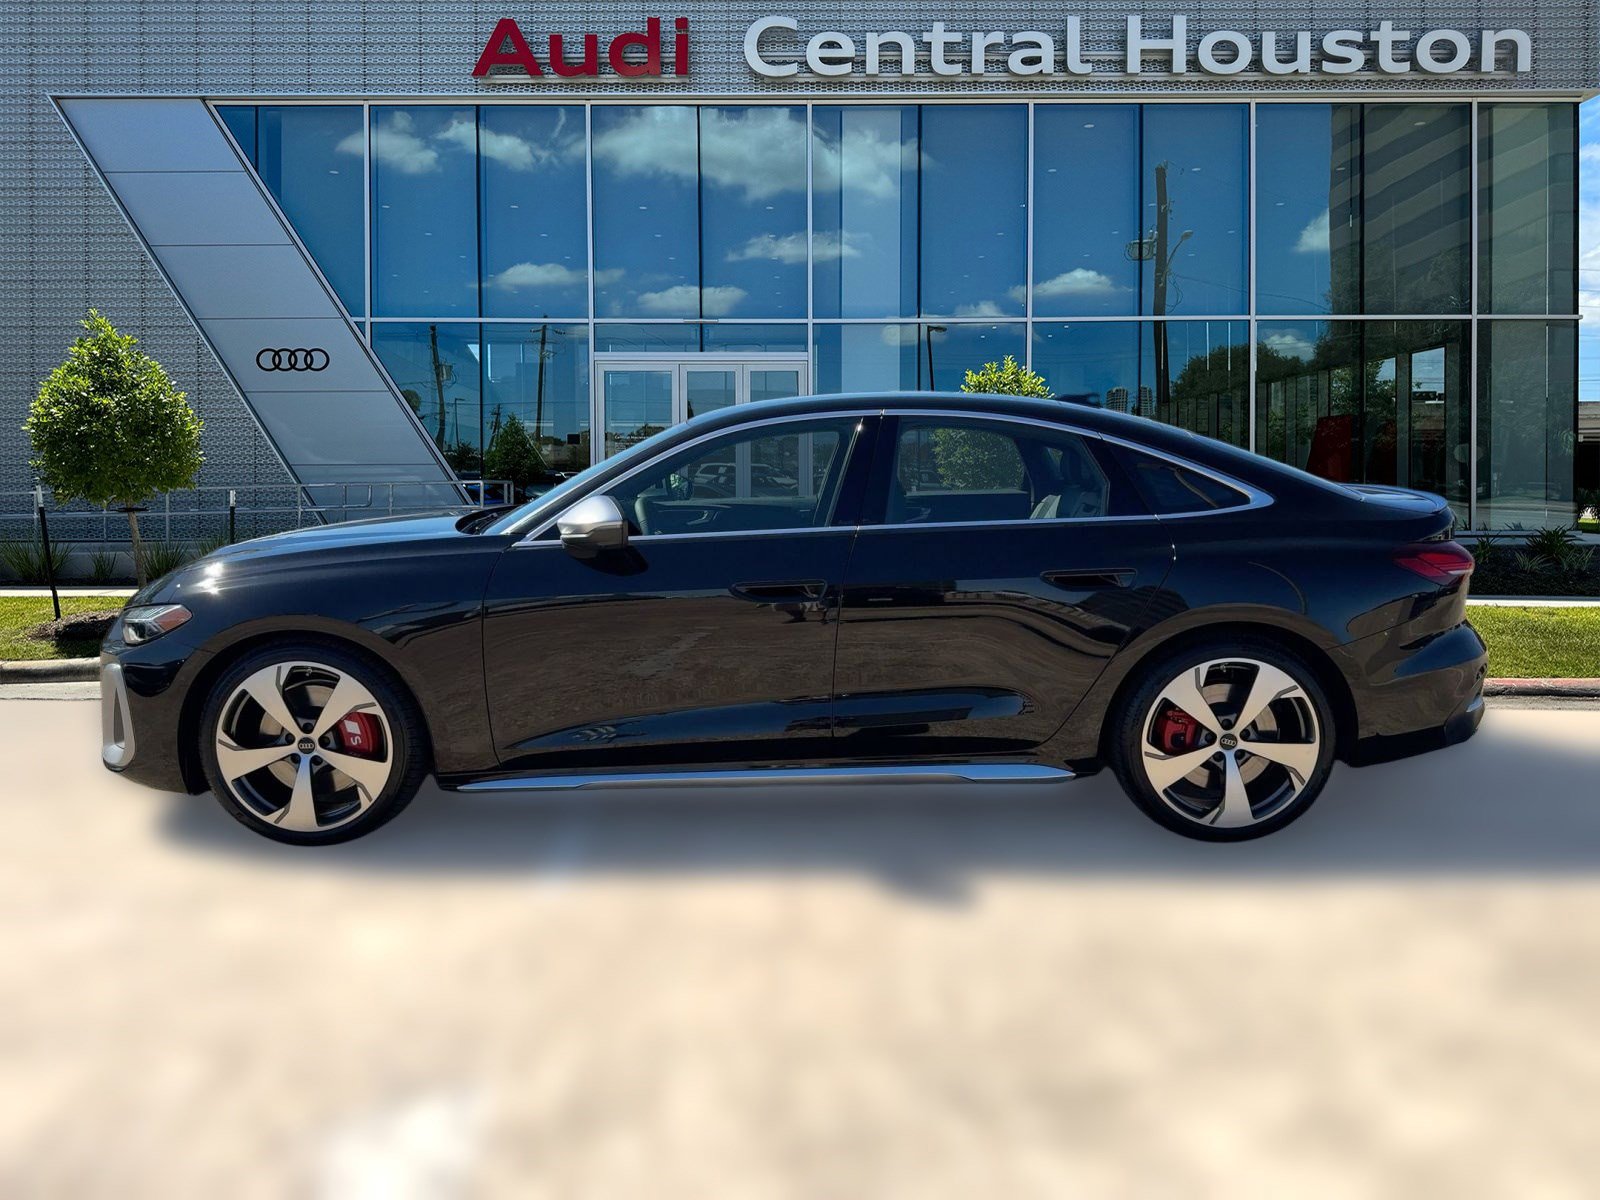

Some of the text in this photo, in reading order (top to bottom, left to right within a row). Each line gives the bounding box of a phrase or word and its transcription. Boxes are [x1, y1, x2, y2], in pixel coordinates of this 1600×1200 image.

[472, 15, 1532, 77] Audi Central Houston
[350, 735, 361, 745] S
